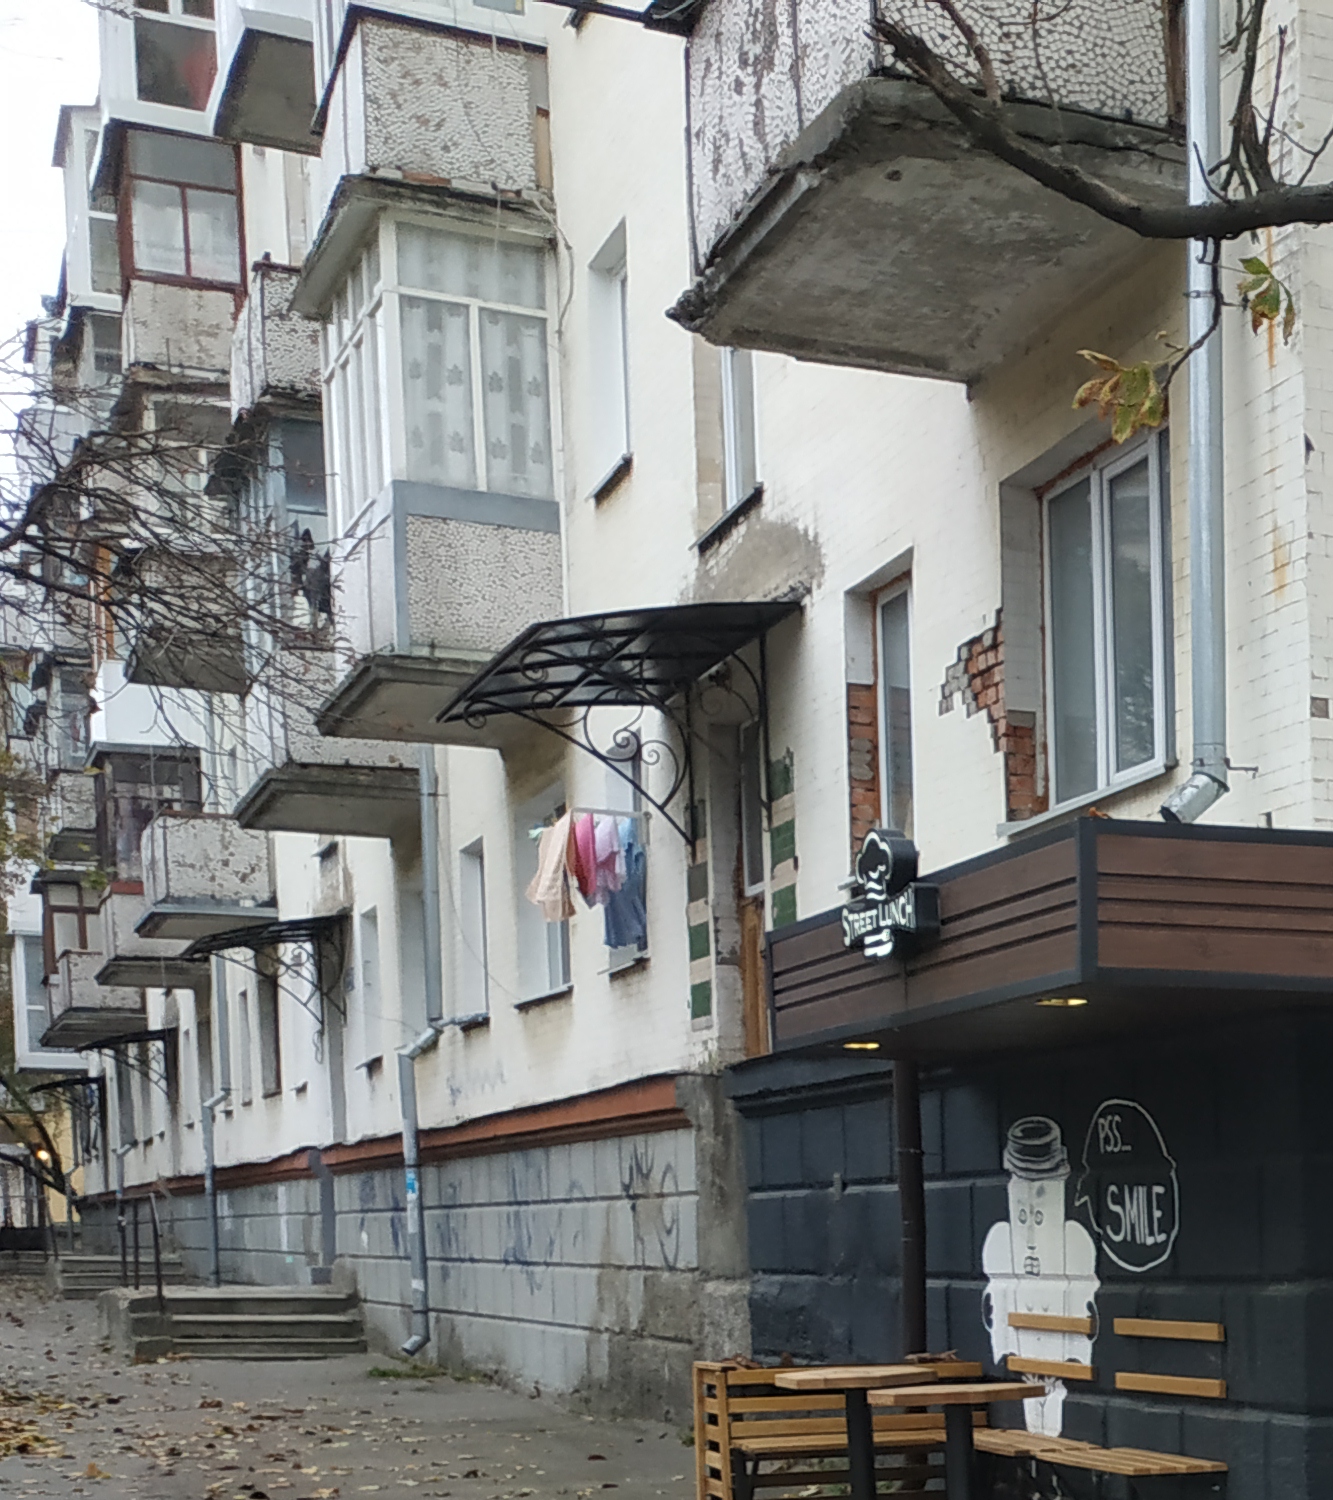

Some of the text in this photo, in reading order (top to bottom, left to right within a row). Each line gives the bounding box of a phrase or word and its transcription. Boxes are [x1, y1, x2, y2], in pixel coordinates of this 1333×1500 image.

[842, 888, 916, 947] STREET LUNCH
[1106, 1184, 1167, 1246] SMILE
